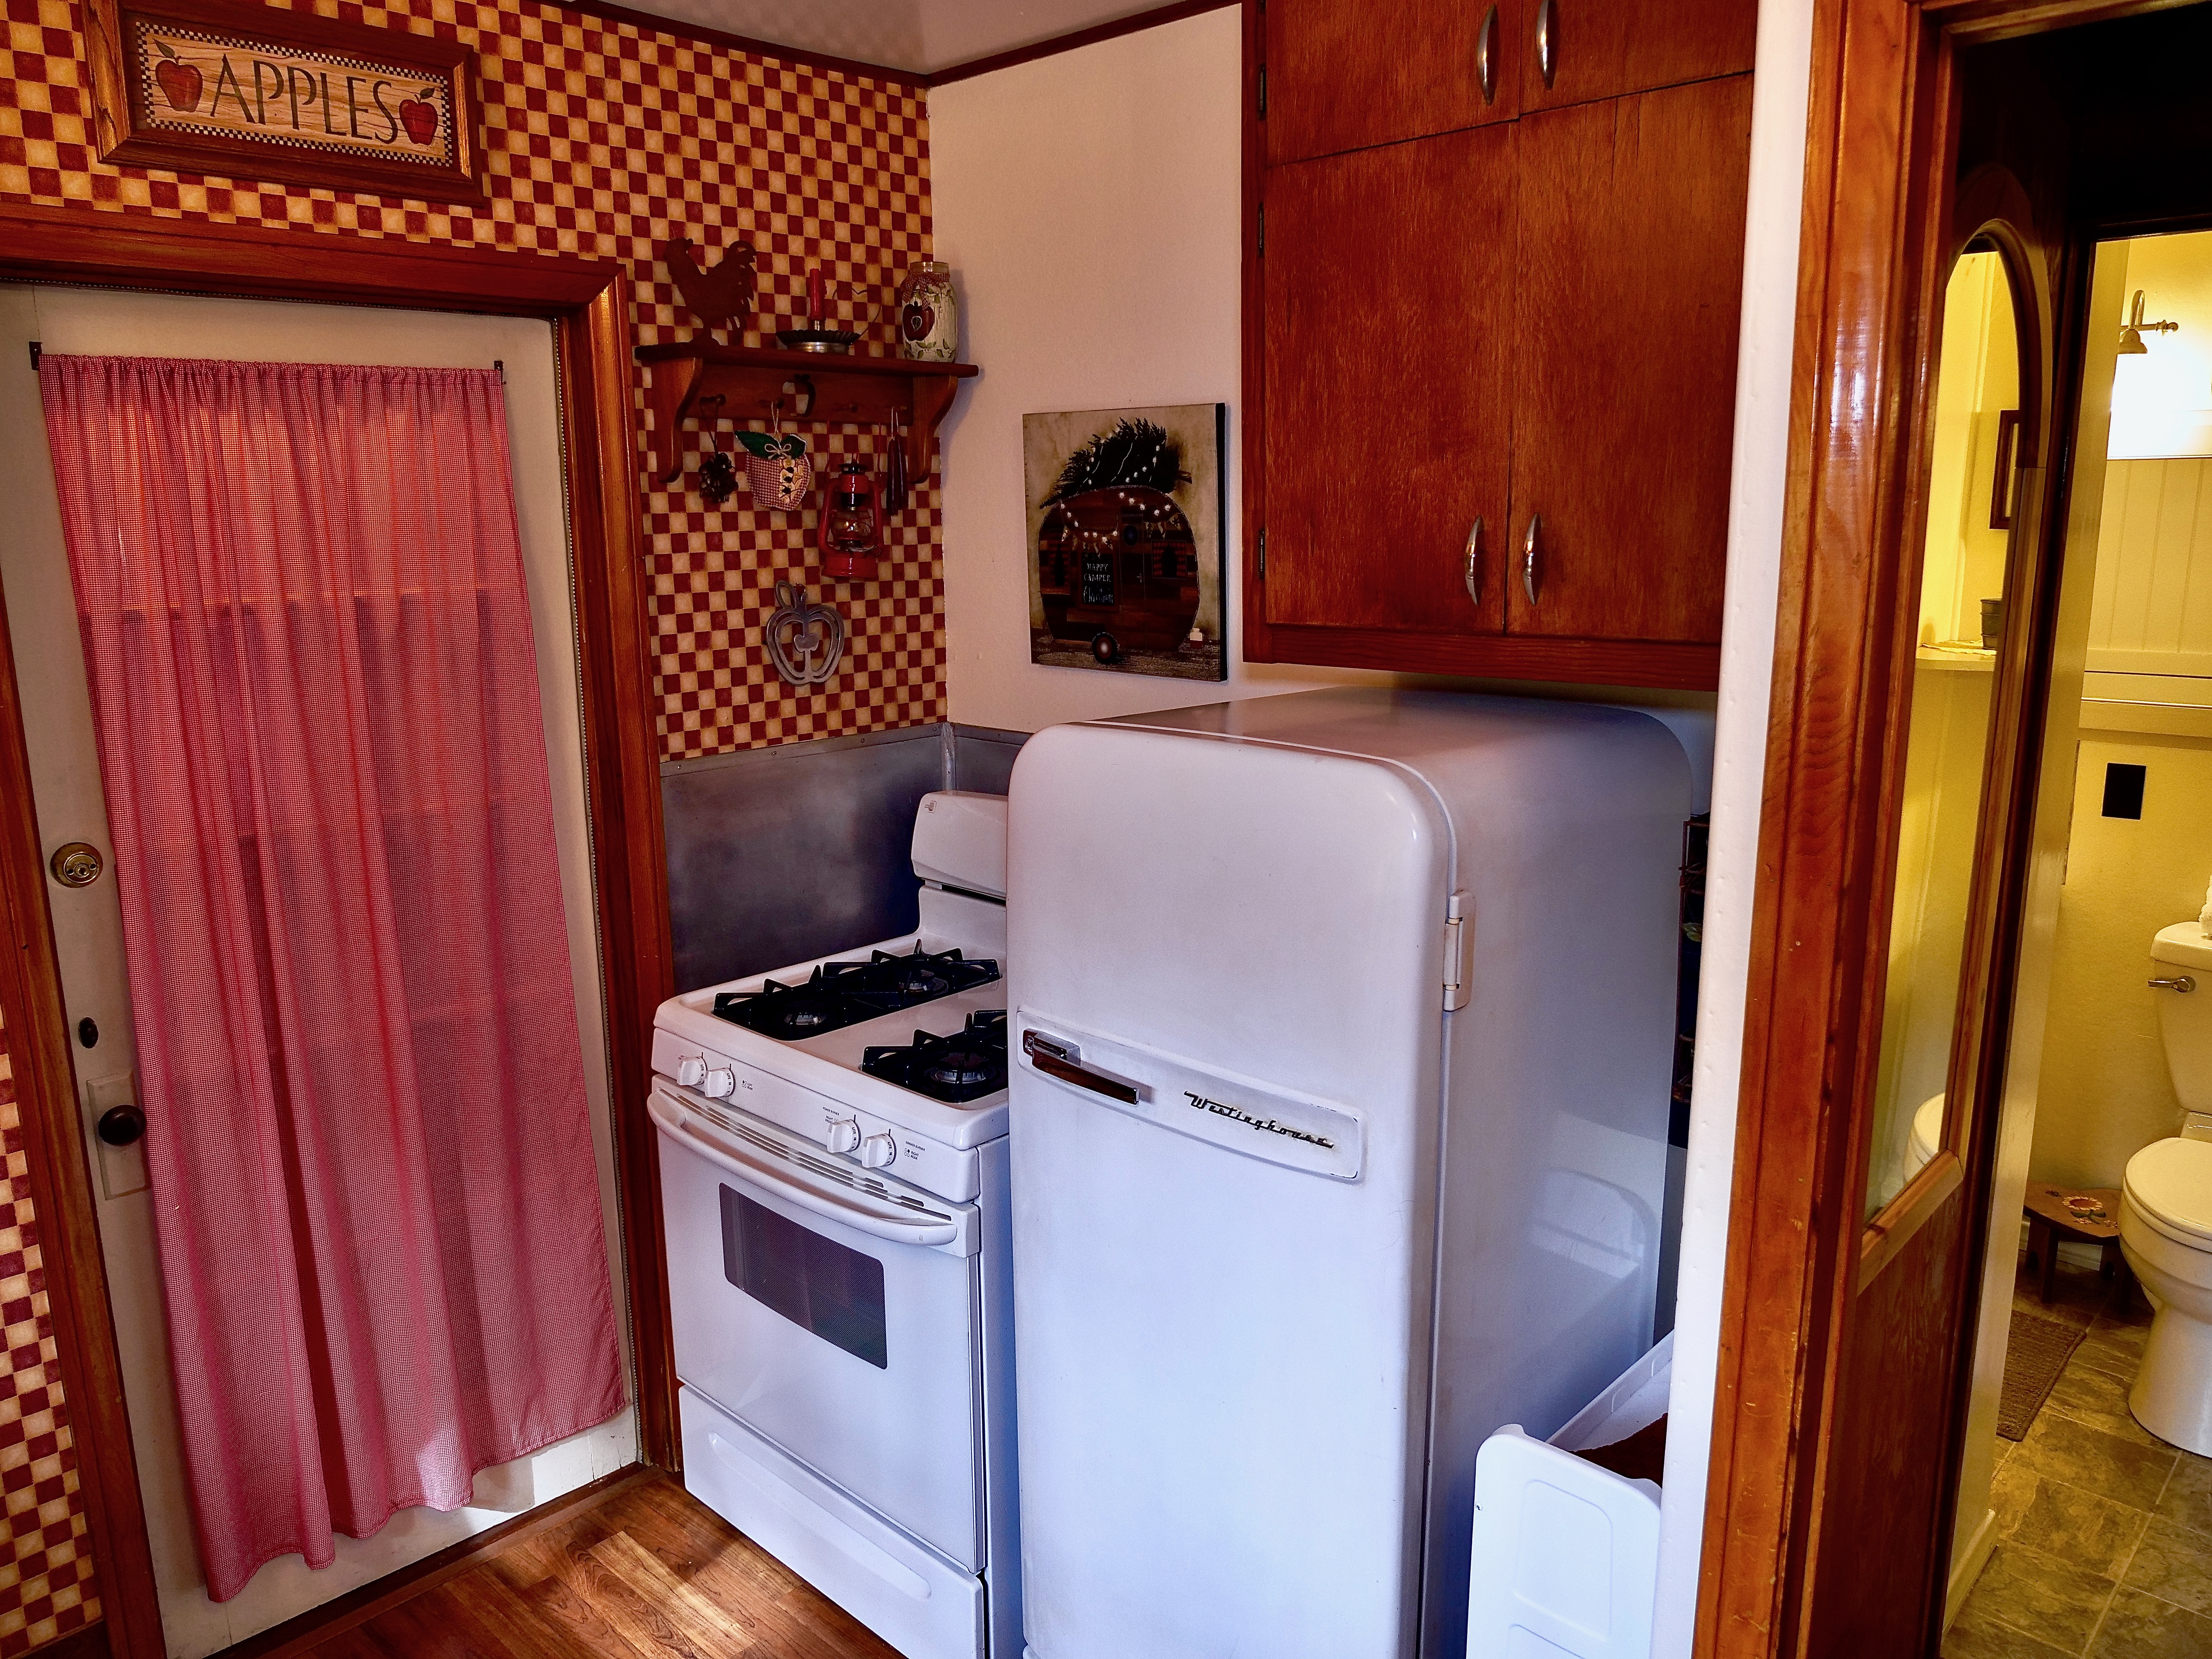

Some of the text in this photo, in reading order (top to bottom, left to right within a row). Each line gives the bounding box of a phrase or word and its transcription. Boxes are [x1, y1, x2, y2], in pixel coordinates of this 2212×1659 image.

[210, 54, 399, 144] APPLES
[1084, 573, 1111, 582] CAMPER
[1087, 563, 1108, 571] HAPPY
[1184, 1091, 1334, 1149] Westinghouse
